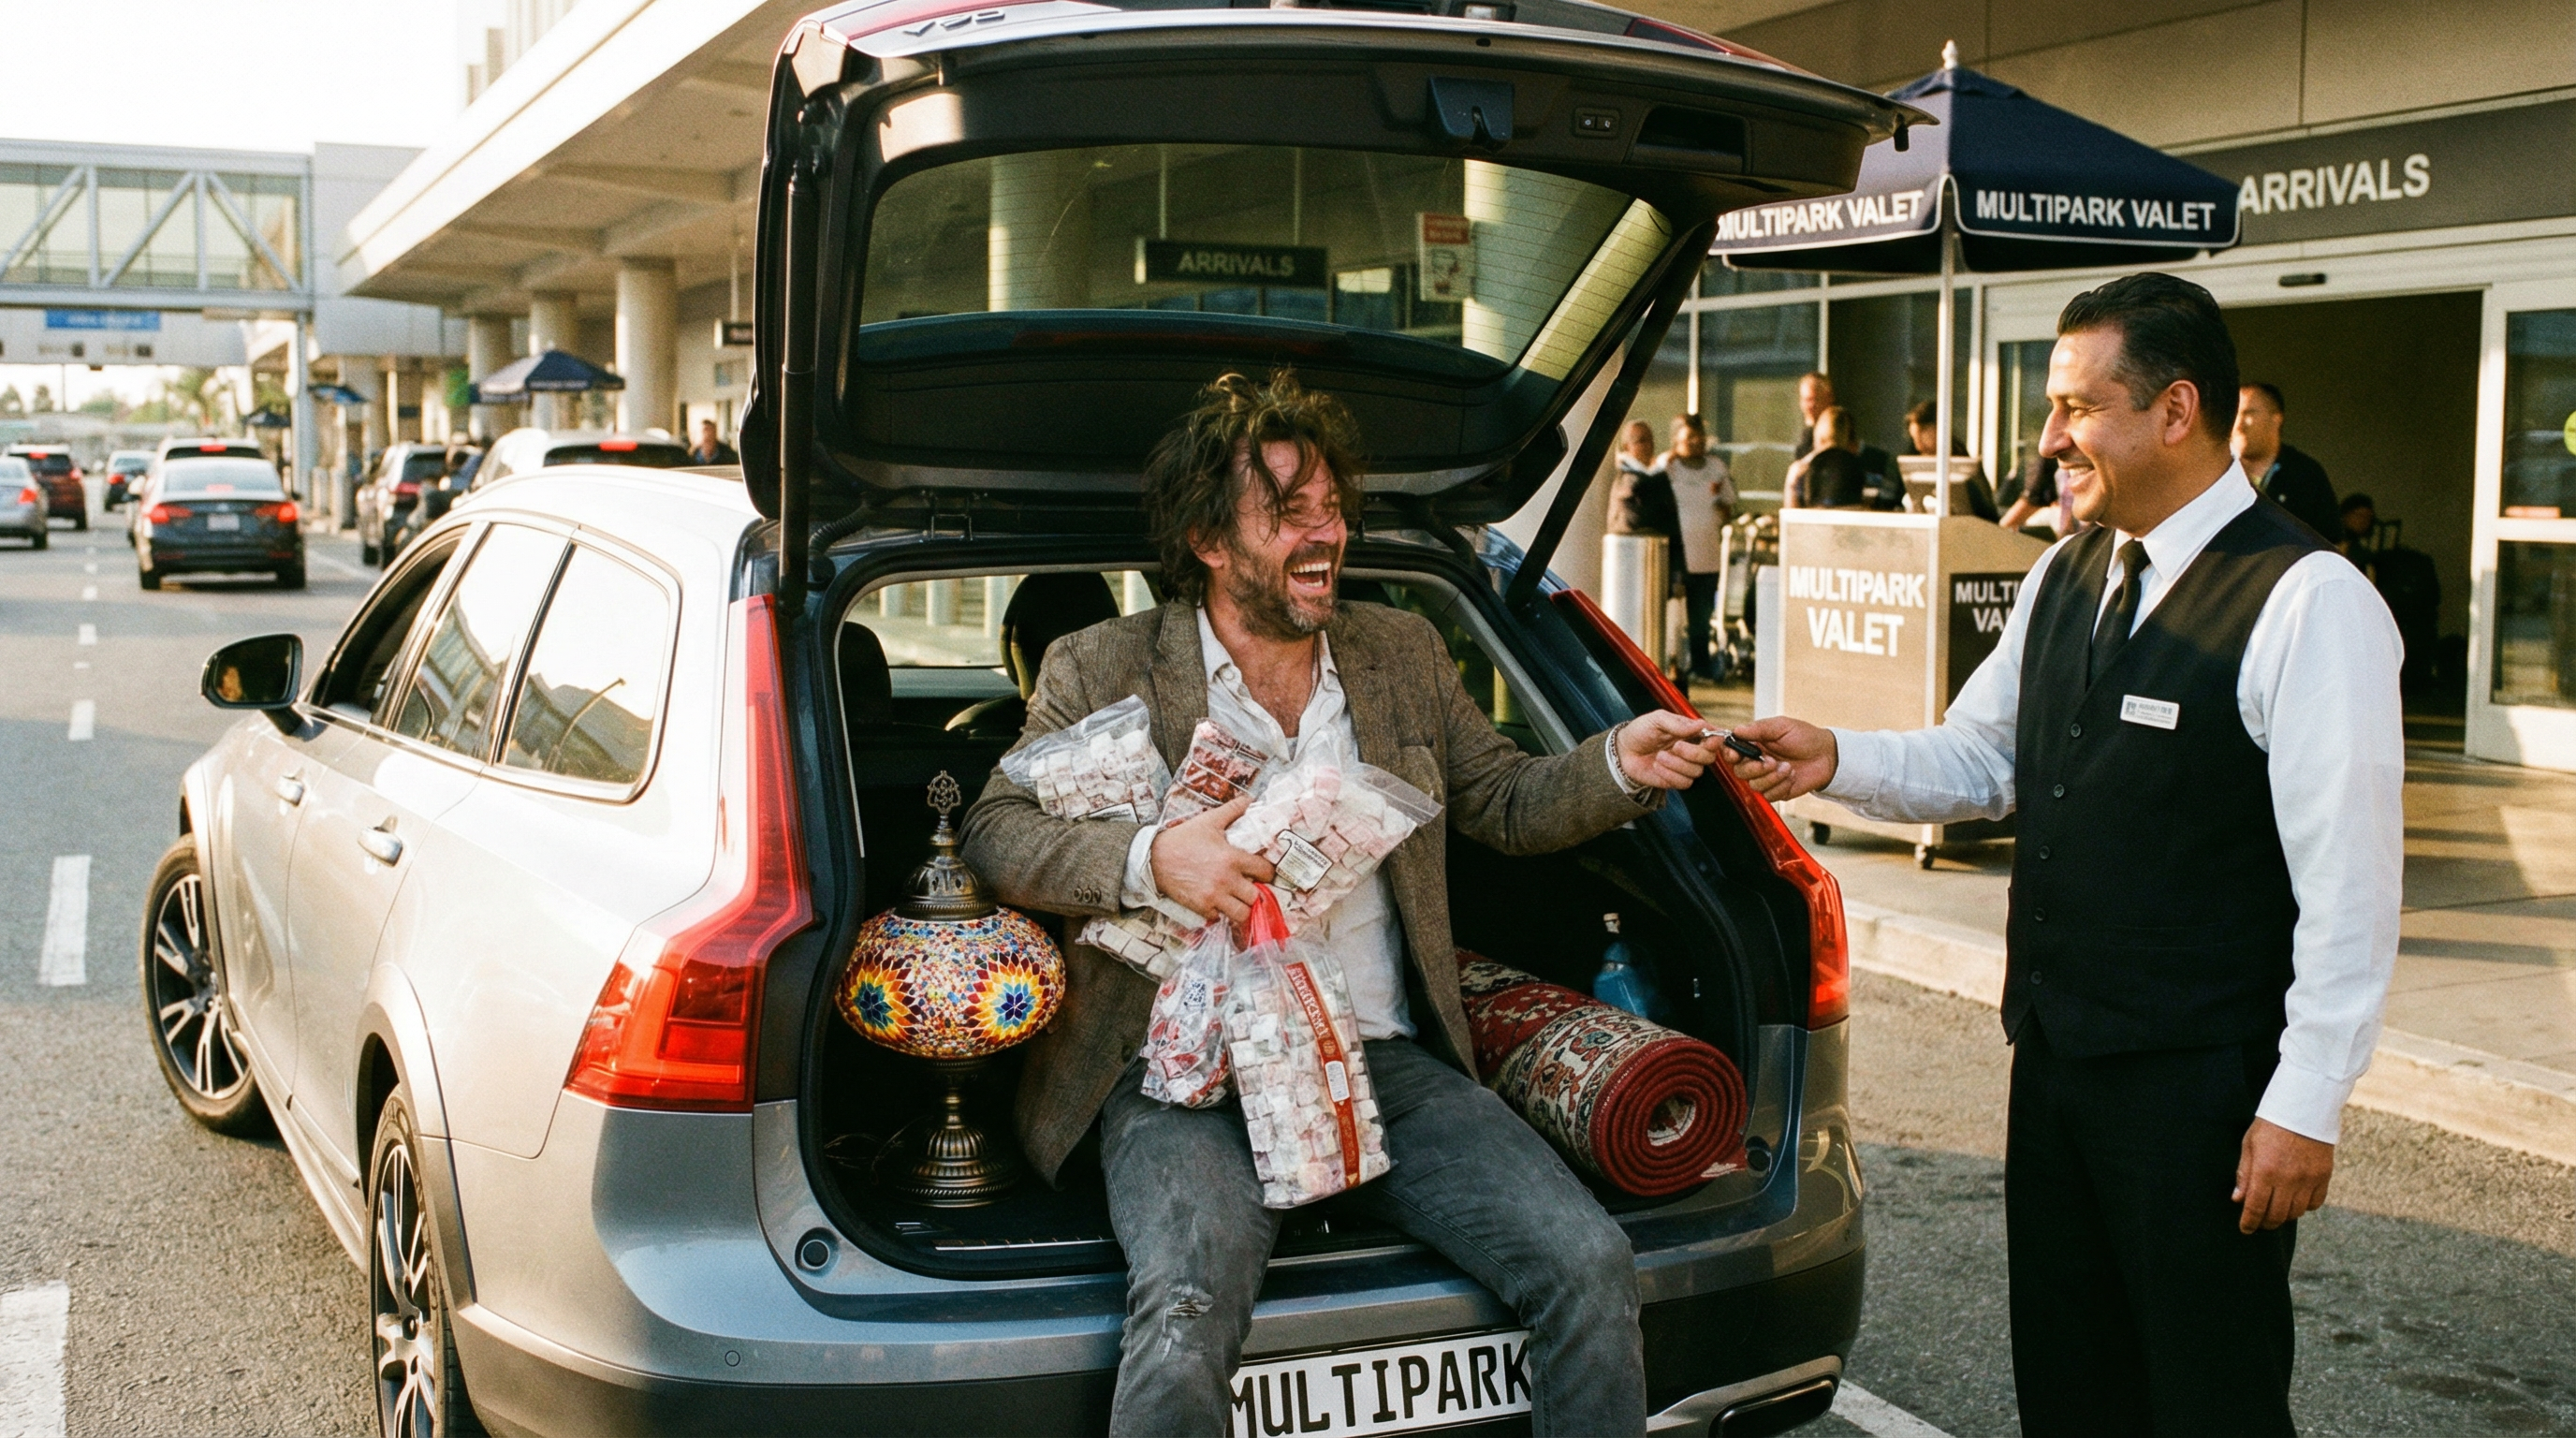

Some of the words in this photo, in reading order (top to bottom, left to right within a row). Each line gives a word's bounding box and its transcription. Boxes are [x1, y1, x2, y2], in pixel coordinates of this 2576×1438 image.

[2237, 152, 2432, 215] ARRIVALS
[1715, 198, 1845, 242] MULTIPARK
[1847, 189, 1925, 227] VALET
[1976, 189, 2126, 227] MULTIPARK
[2130, 198, 2217, 231] VALET
[1176, 250, 1295, 278] ARRIVALS
[1788, 565, 1926, 609] MULTIPARK
[1807, 606, 1906, 657] VALET
[1225, 1337, 1532, 1438] MULTIPARK
